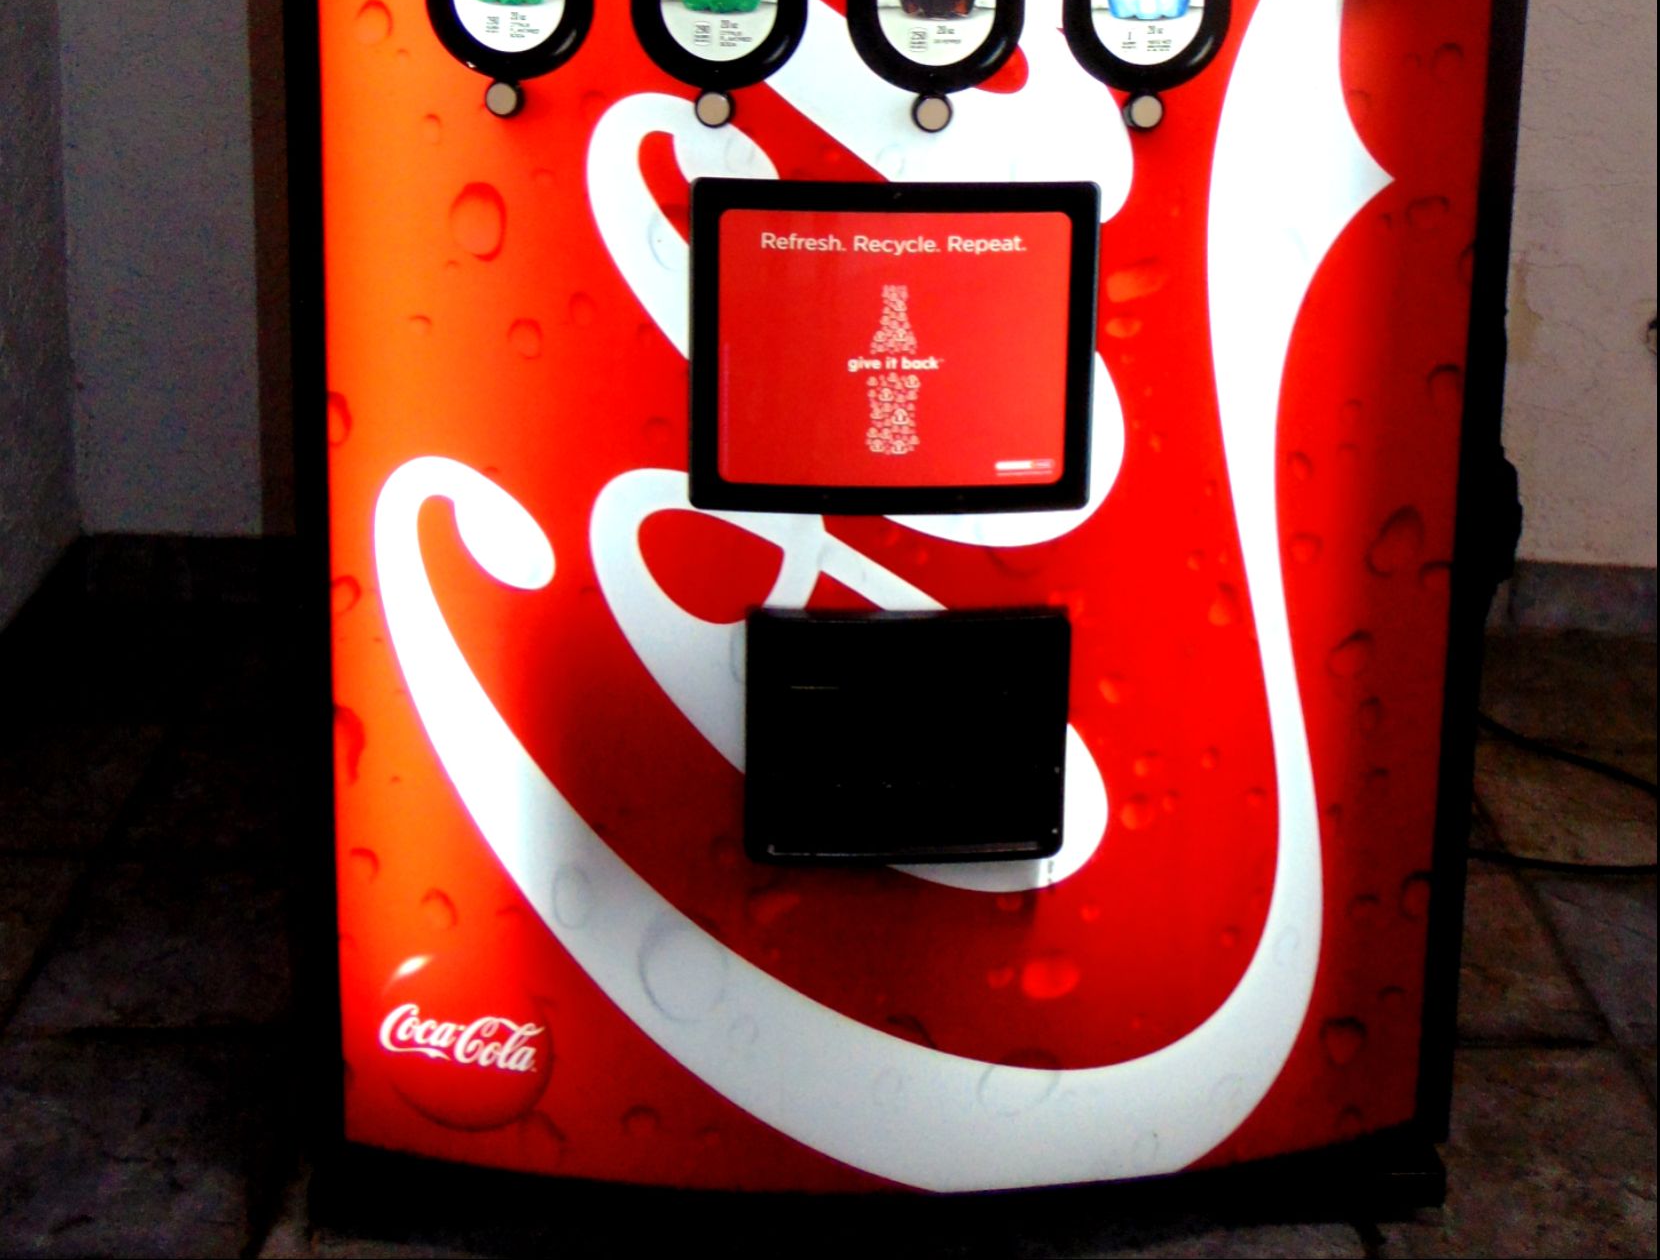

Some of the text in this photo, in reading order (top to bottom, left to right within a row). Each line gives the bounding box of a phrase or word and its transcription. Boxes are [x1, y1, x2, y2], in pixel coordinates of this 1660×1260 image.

[760, 231, 1027, 255] Refresh. Recycle. Repeat.
[847, 356, 939, 372] give it back
